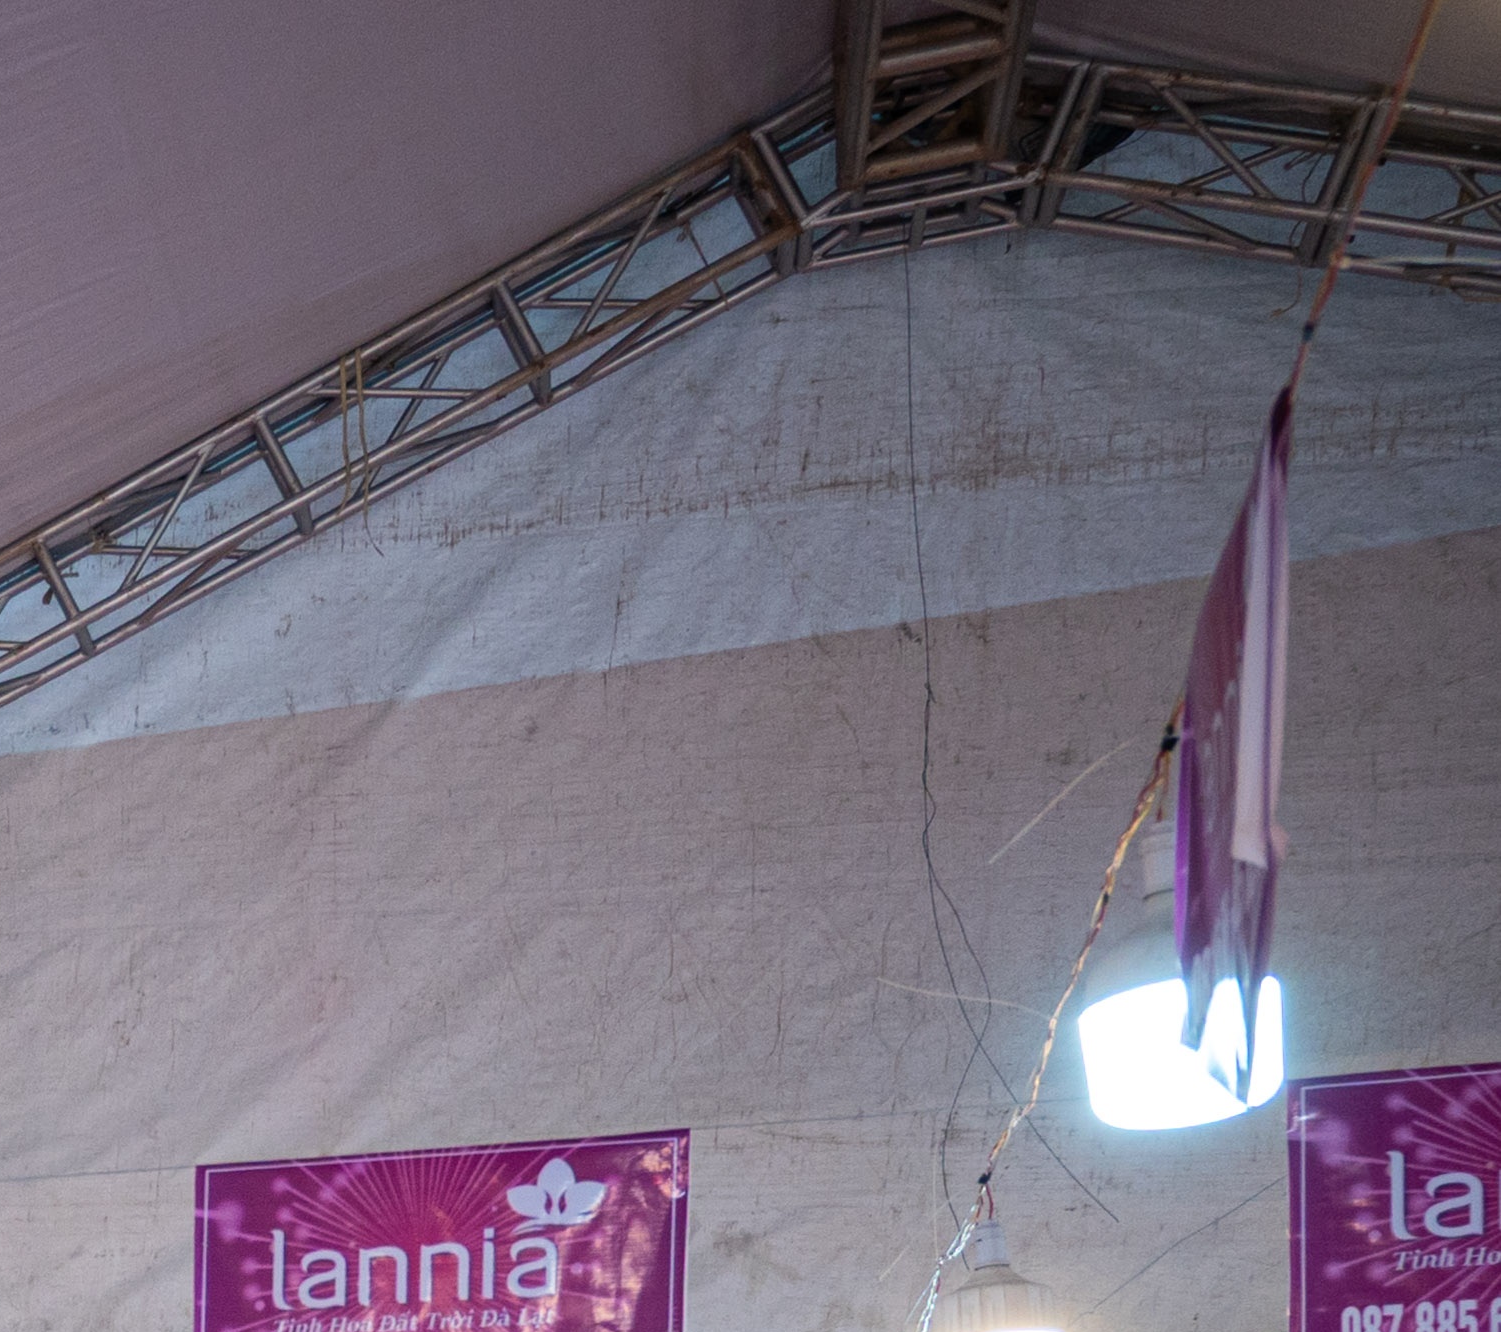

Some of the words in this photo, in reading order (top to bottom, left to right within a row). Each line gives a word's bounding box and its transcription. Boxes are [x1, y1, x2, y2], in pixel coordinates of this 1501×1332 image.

[271, 1228, 560, 1311] lannia
[1394, 1247, 1456, 1271] Tinh
[378, 1309, 417, 1332] Đất
[481, 1306, 511, 1328] Đà
